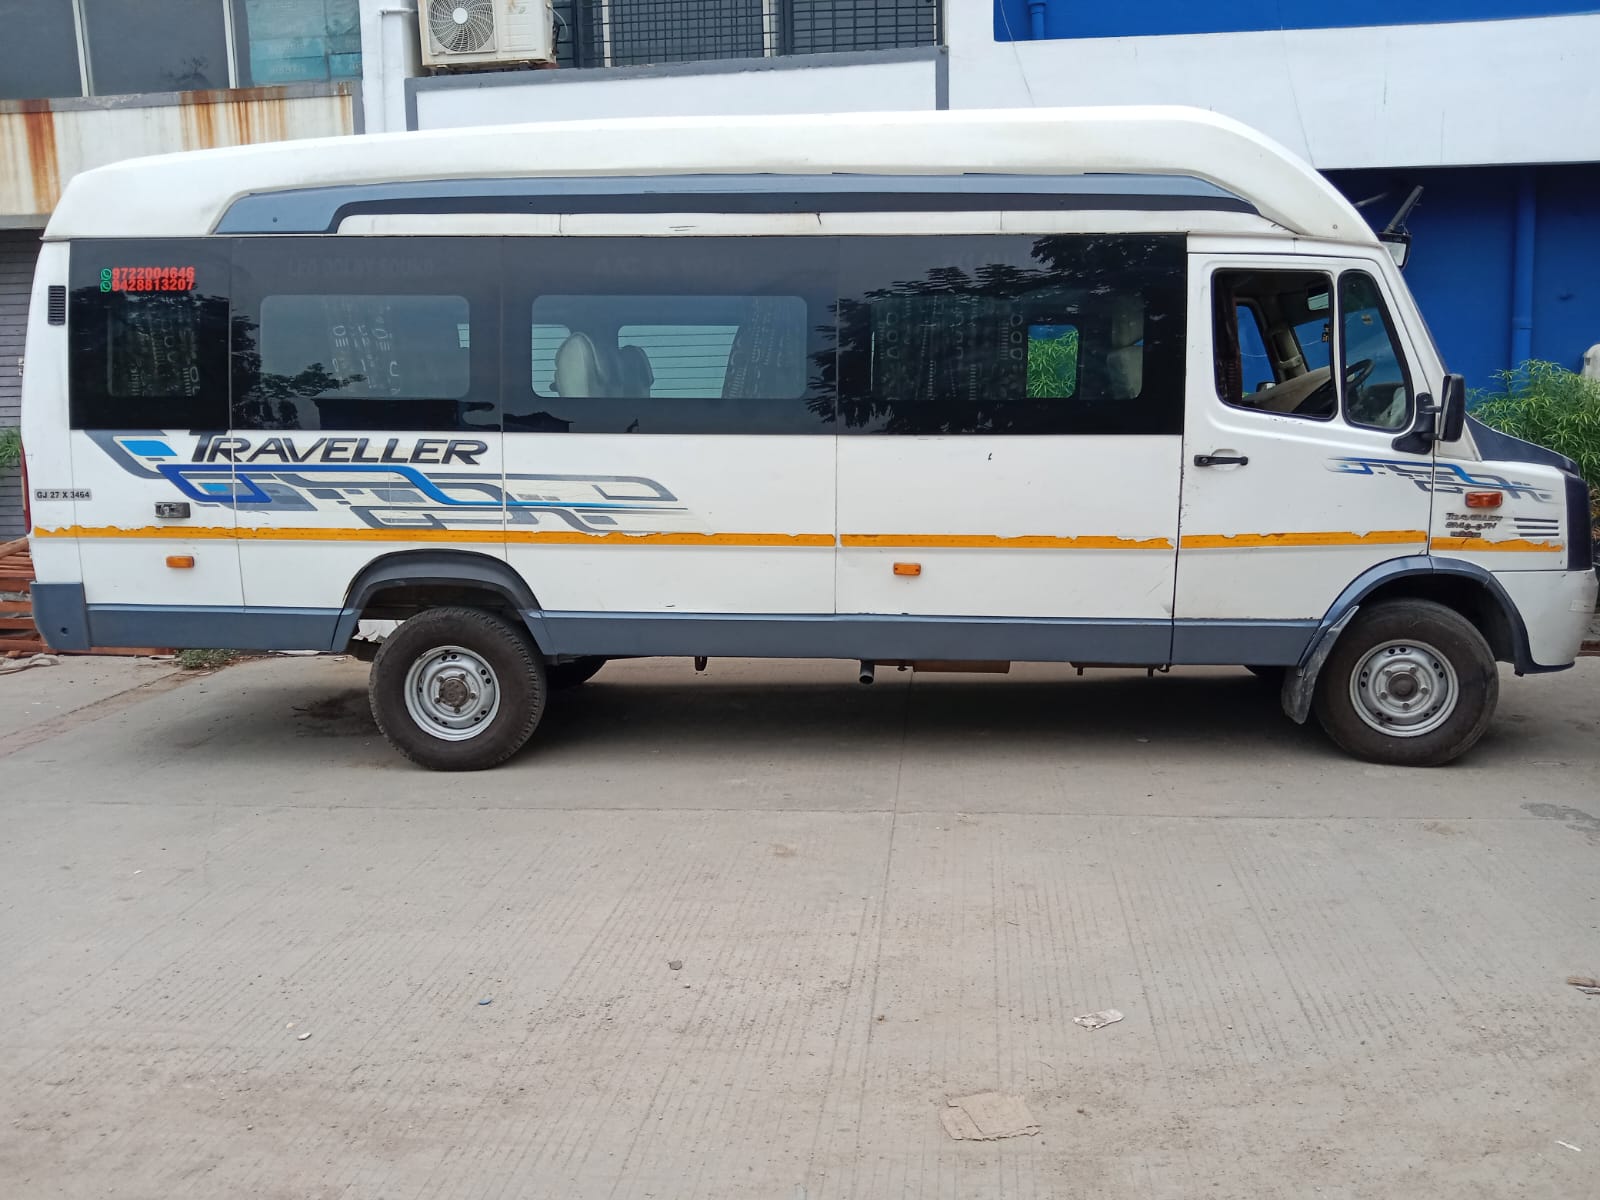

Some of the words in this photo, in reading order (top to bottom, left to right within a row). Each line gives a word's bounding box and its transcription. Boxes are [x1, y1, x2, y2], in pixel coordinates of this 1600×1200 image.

[112, 266, 195, 280] 9722004646
[112, 278, 194, 291] 9428813207
[189, 430, 488, 465] TRAVELLER
[36, 491, 48, 499] GJ
[50, 491, 60, 499] 27
[62, 491, 68, 499] X
